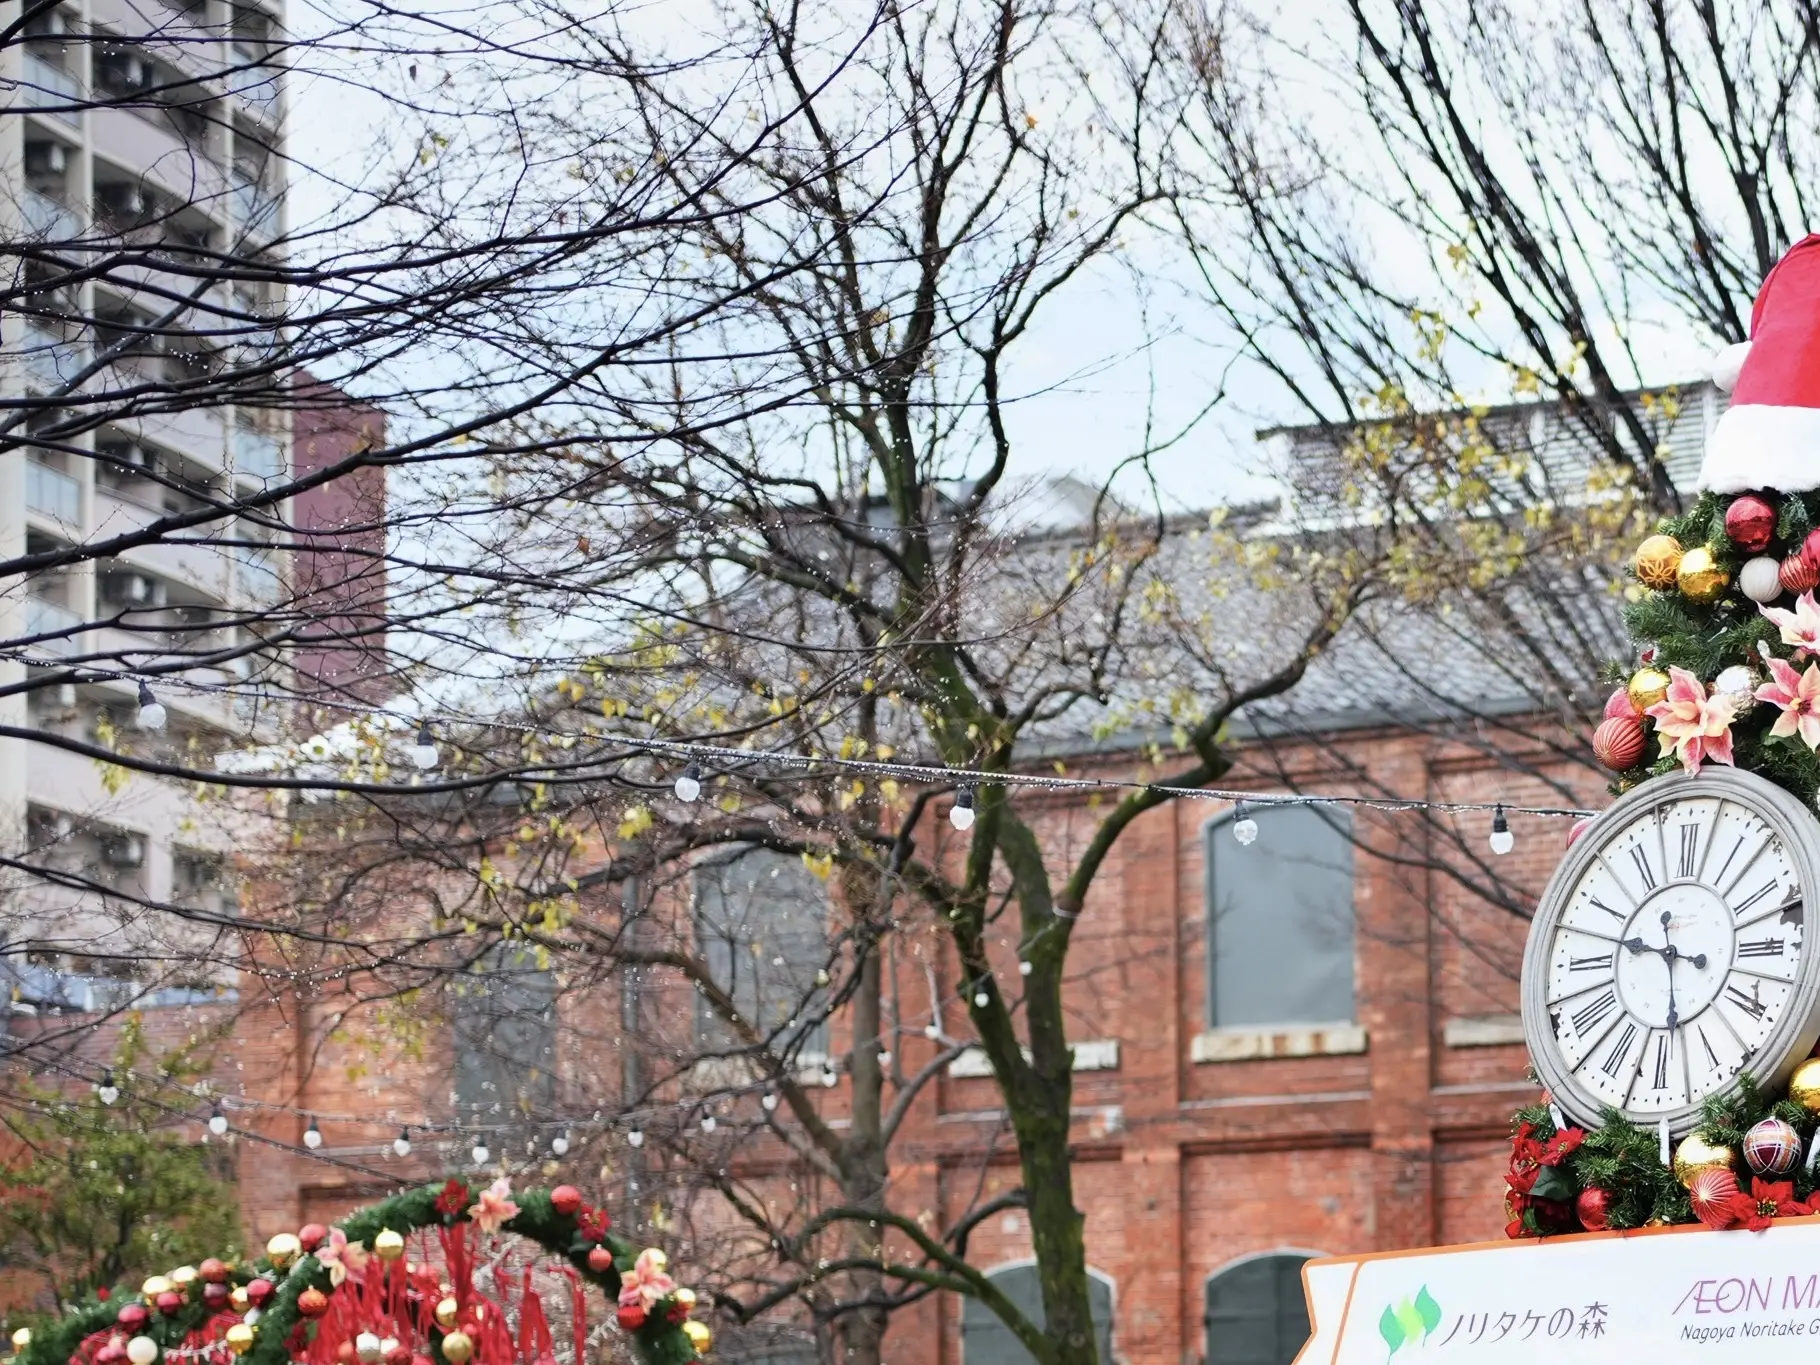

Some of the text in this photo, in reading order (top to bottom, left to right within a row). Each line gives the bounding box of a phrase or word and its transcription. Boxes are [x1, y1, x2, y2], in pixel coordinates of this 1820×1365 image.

[1628, 842, 1658, 897] XI
[1674, 823, 1700, 878] XII
[1588, 894, 1629, 925] X
[1733, 876, 1780, 916] II
[1569, 952, 1614, 974] IX
[1737, 938, 1785, 960] III
[1571, 987, 1618, 1042] VIII
[1600, 1022, 1639, 1080] VII
[1438, 1300, 1609, 1347] ノリタケの森
[1680, 1323, 1736, 1345] Nagoya
[1739, 1318, 1805, 1338] Noritake
